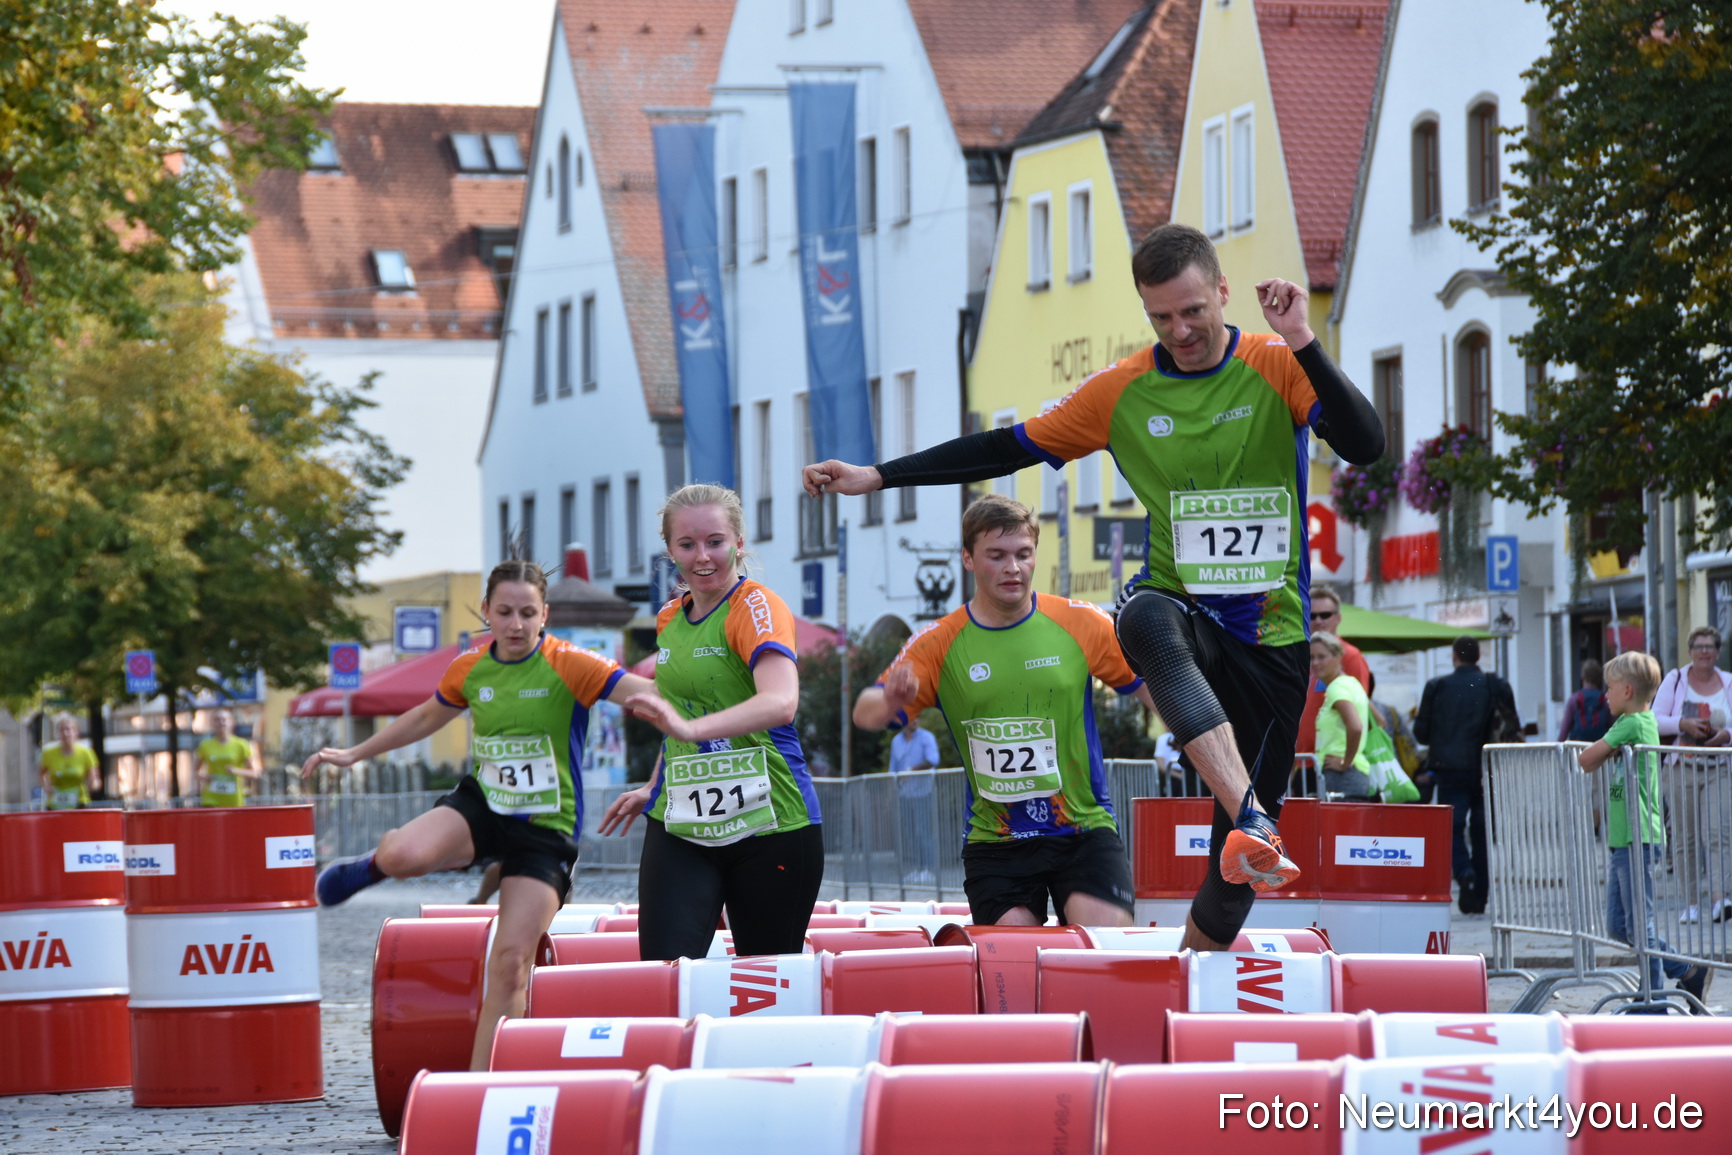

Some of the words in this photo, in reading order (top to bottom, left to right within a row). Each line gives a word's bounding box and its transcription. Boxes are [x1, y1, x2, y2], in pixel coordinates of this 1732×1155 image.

[1051, 336, 1092, 385] HOTEL
[1213, 405, 1252, 424] BOCK
[1181, 492, 1281, 517] BOCK
[1200, 525, 1264, 556] 127
[1199, 566, 1266, 581] MARTIN
[1493, 542, 1512, 585] P
[693, 646, 728, 657] BOCK
[1025, 656, 1060, 669] BOCK
[971, 720, 1047, 741] BOCK
[474, 740, 546, 759] BOCK
[672, 752, 758, 783] BOCK
[986, 747, 1037, 773] 122
[989, 780, 1036, 793] JONAS
[488, 790, 542, 806] DANIELA
[688, 785, 745, 817] 121
[692, 818, 748, 838] LAURA
